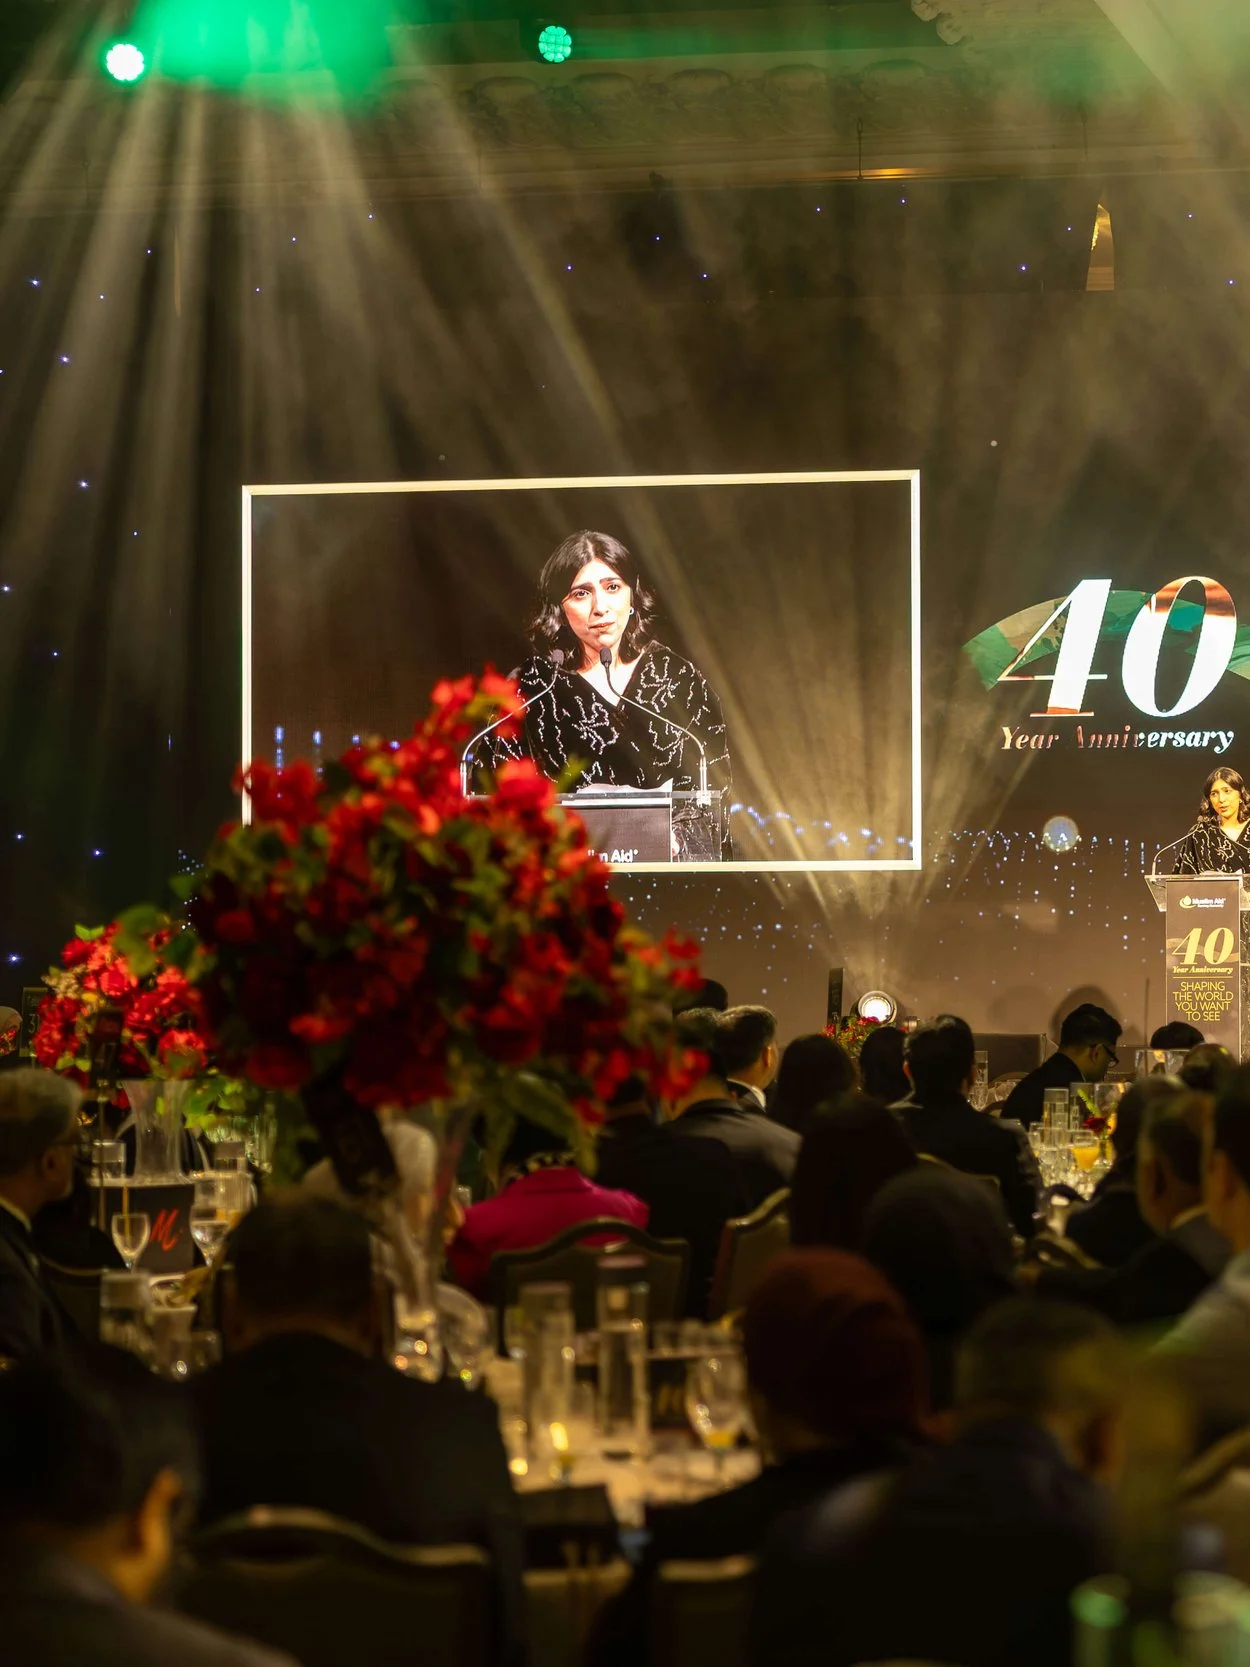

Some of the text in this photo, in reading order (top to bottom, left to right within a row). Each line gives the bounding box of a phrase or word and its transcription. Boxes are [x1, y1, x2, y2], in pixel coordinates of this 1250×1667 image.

[997, 575, 1238, 718] 40
[1000, 726, 1060, 750] Year
[1172, 927, 1235, 965] 40
[1180, 981, 1225, 991] SHAPING
[1172, 991, 1234, 1001] THE WORLD
[1175, 1001, 1231, 1011] YOU WANT
[1185, 1010, 1221, 1021] TO SEE
